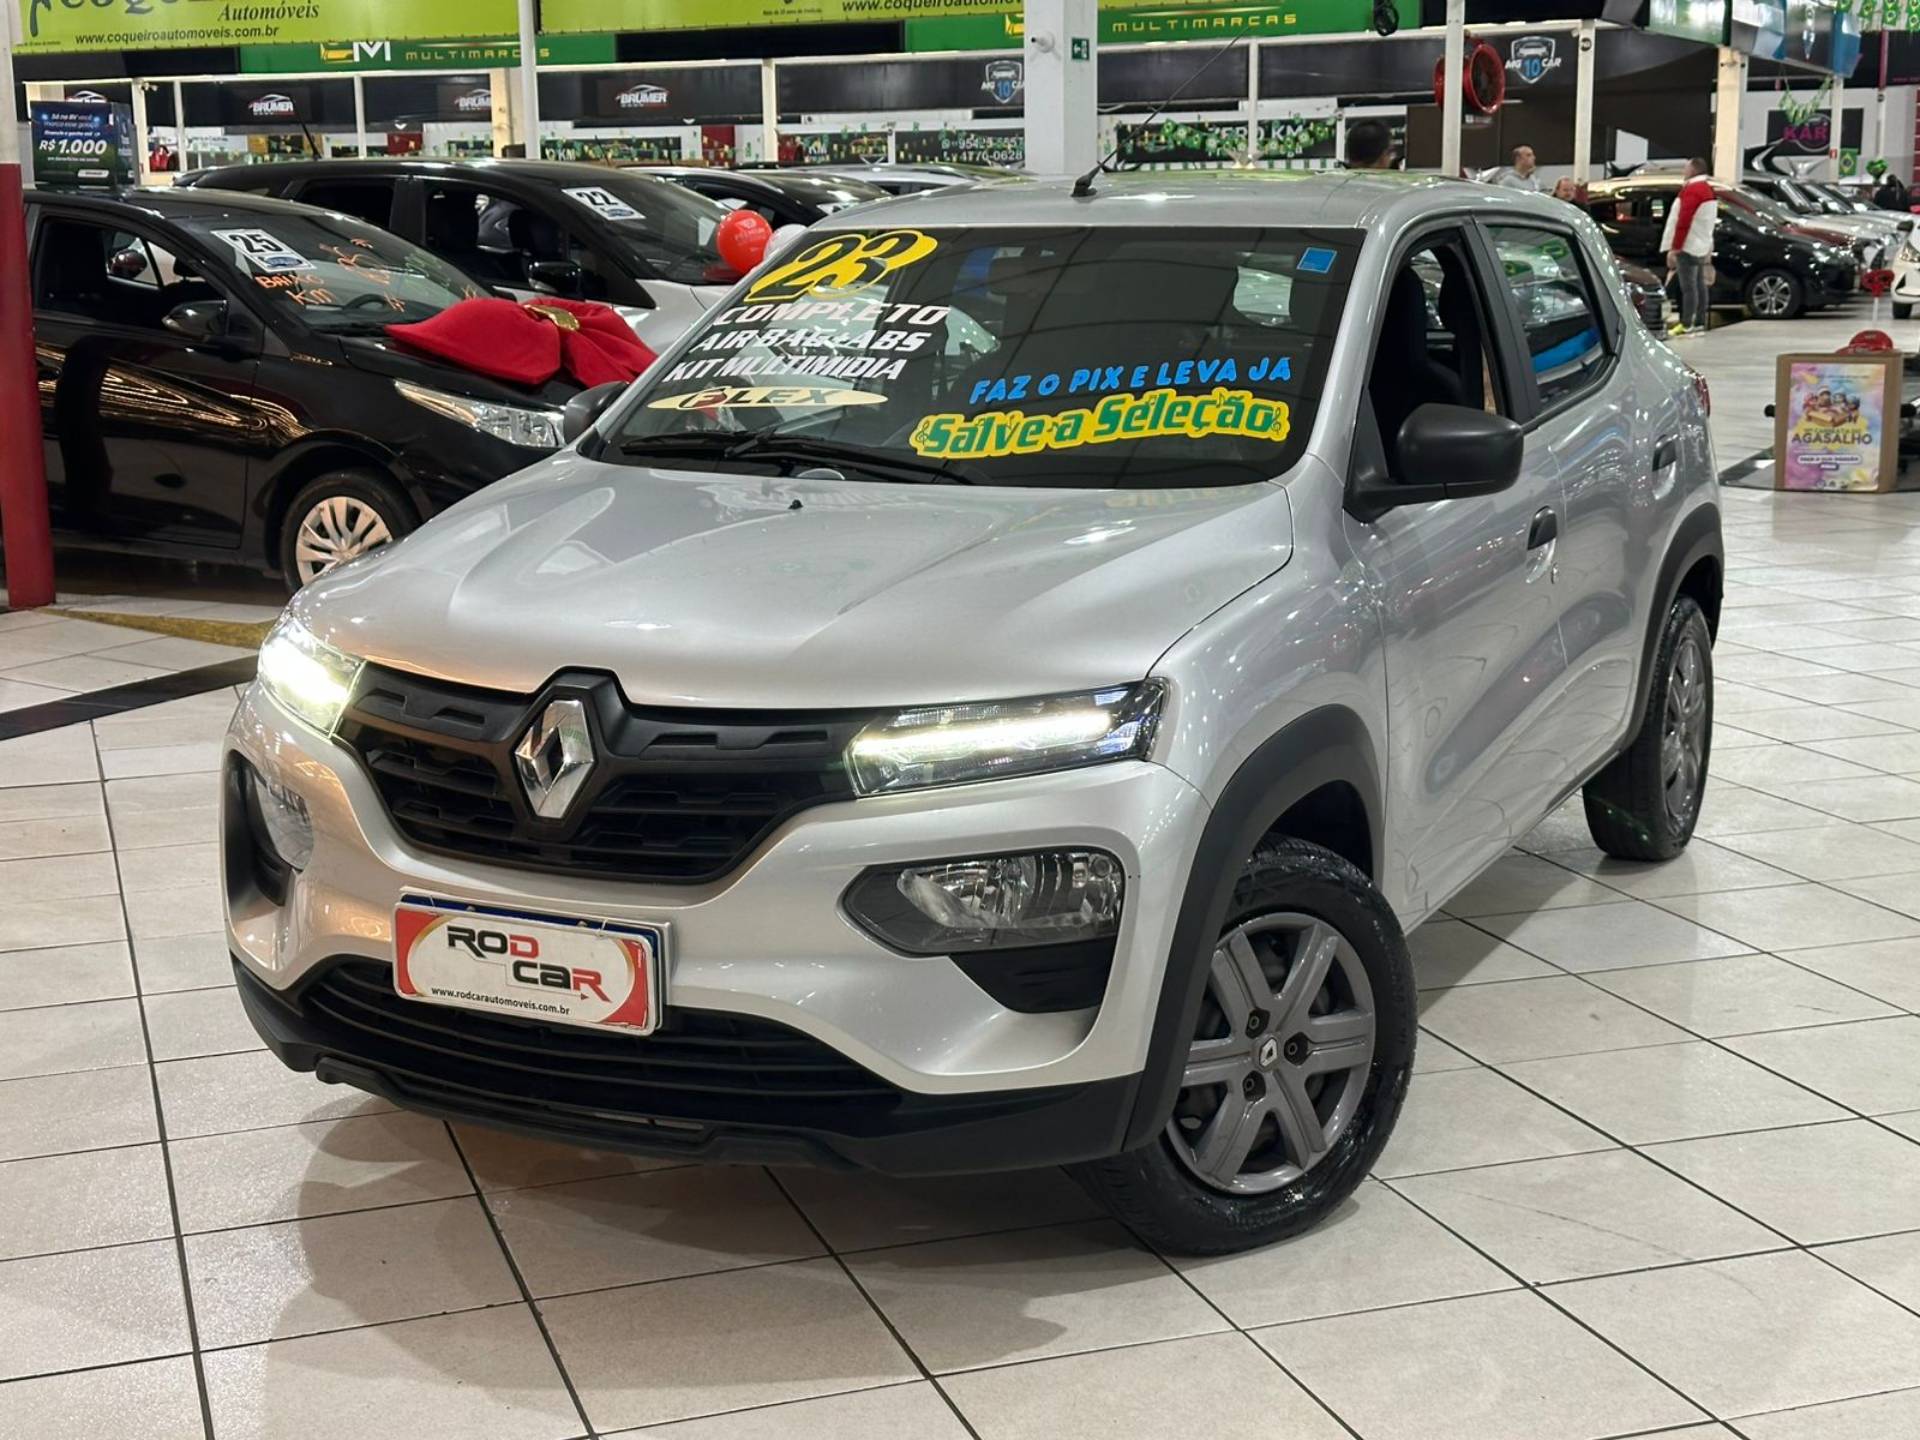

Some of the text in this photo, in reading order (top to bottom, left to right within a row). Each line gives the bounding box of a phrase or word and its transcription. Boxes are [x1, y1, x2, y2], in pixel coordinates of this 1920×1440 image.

[218, 1, 320, 22] Automóveis
[1112, 13, 1298, 33] MULTIMARCAS
[75, 25, 280, 45] www.coqueiroautomoveis.com.br
[405, 48, 551, 61] MULTIMARCS
[39, 139, 107, 155] R$ 1.000
[577, 191, 618, 206] 22
[228, 233, 283, 253] 25
[744, 229, 938, 302] 23
[712, 303, 953, 327] COMPLETO
[689, 329, 759, 353] AIR
[662, 355, 907, 383] KIT MULTIMIDIA
[969, 374, 1032, 404] FAZ
[1038, 374, 1060, 396] O
[1069, 366, 1124, 393] PIX
[1130, 364, 1148, 388] E
[1155, 357, 1237, 386] LEVA
[682, 388, 839, 408] FLEX
[922, 392, 1275, 453] Salve a Seleção
[1791, 432, 1873, 445] AGASALHO
[446, 924, 540, 960] ROD
[431, 986, 571, 1016] www.rodcarautomoveis.com.br
